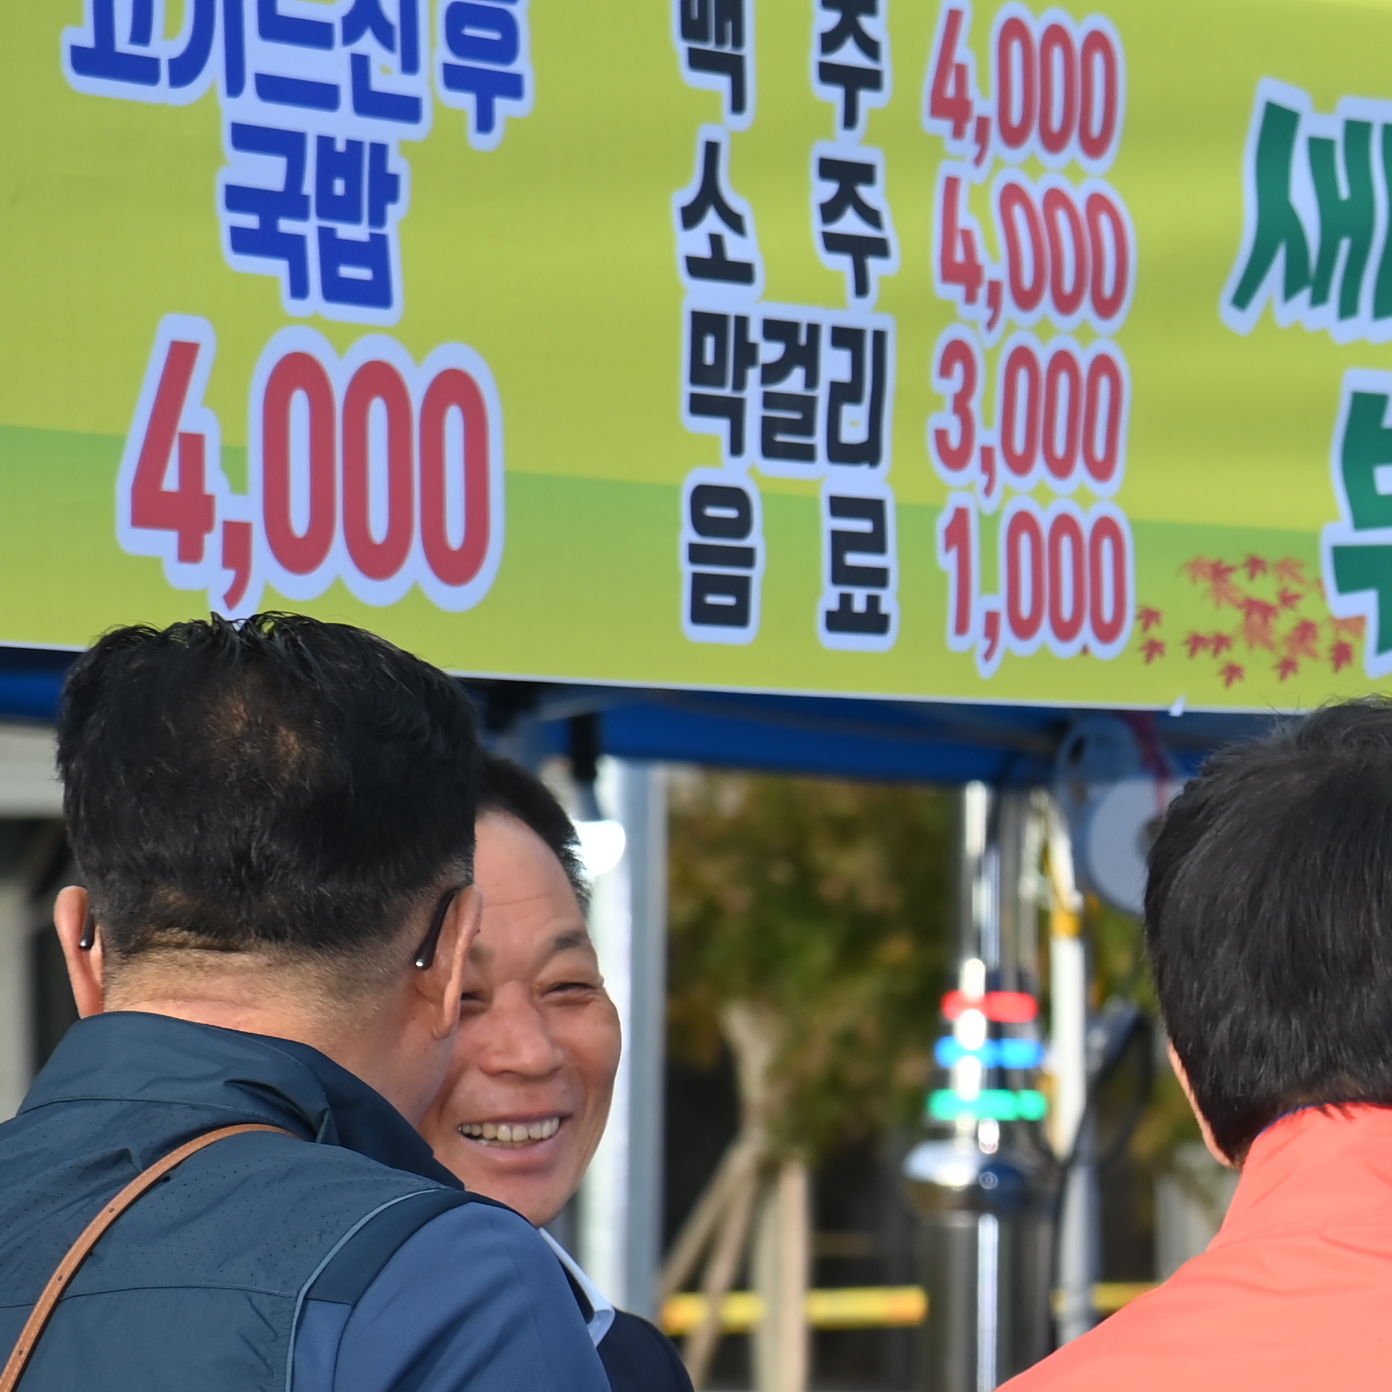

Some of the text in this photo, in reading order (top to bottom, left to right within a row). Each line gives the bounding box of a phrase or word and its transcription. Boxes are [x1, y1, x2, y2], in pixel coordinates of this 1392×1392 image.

[930, 9, 1118, 168] 4,000
[225, 122, 401, 309] 국밥
[940, 177, 1128, 331] 4,000
[131, 340, 492, 610] 4,000
[689, 311, 1122, 497] 막걸리 3,000
[943, 507, 1126, 662] 1,000
